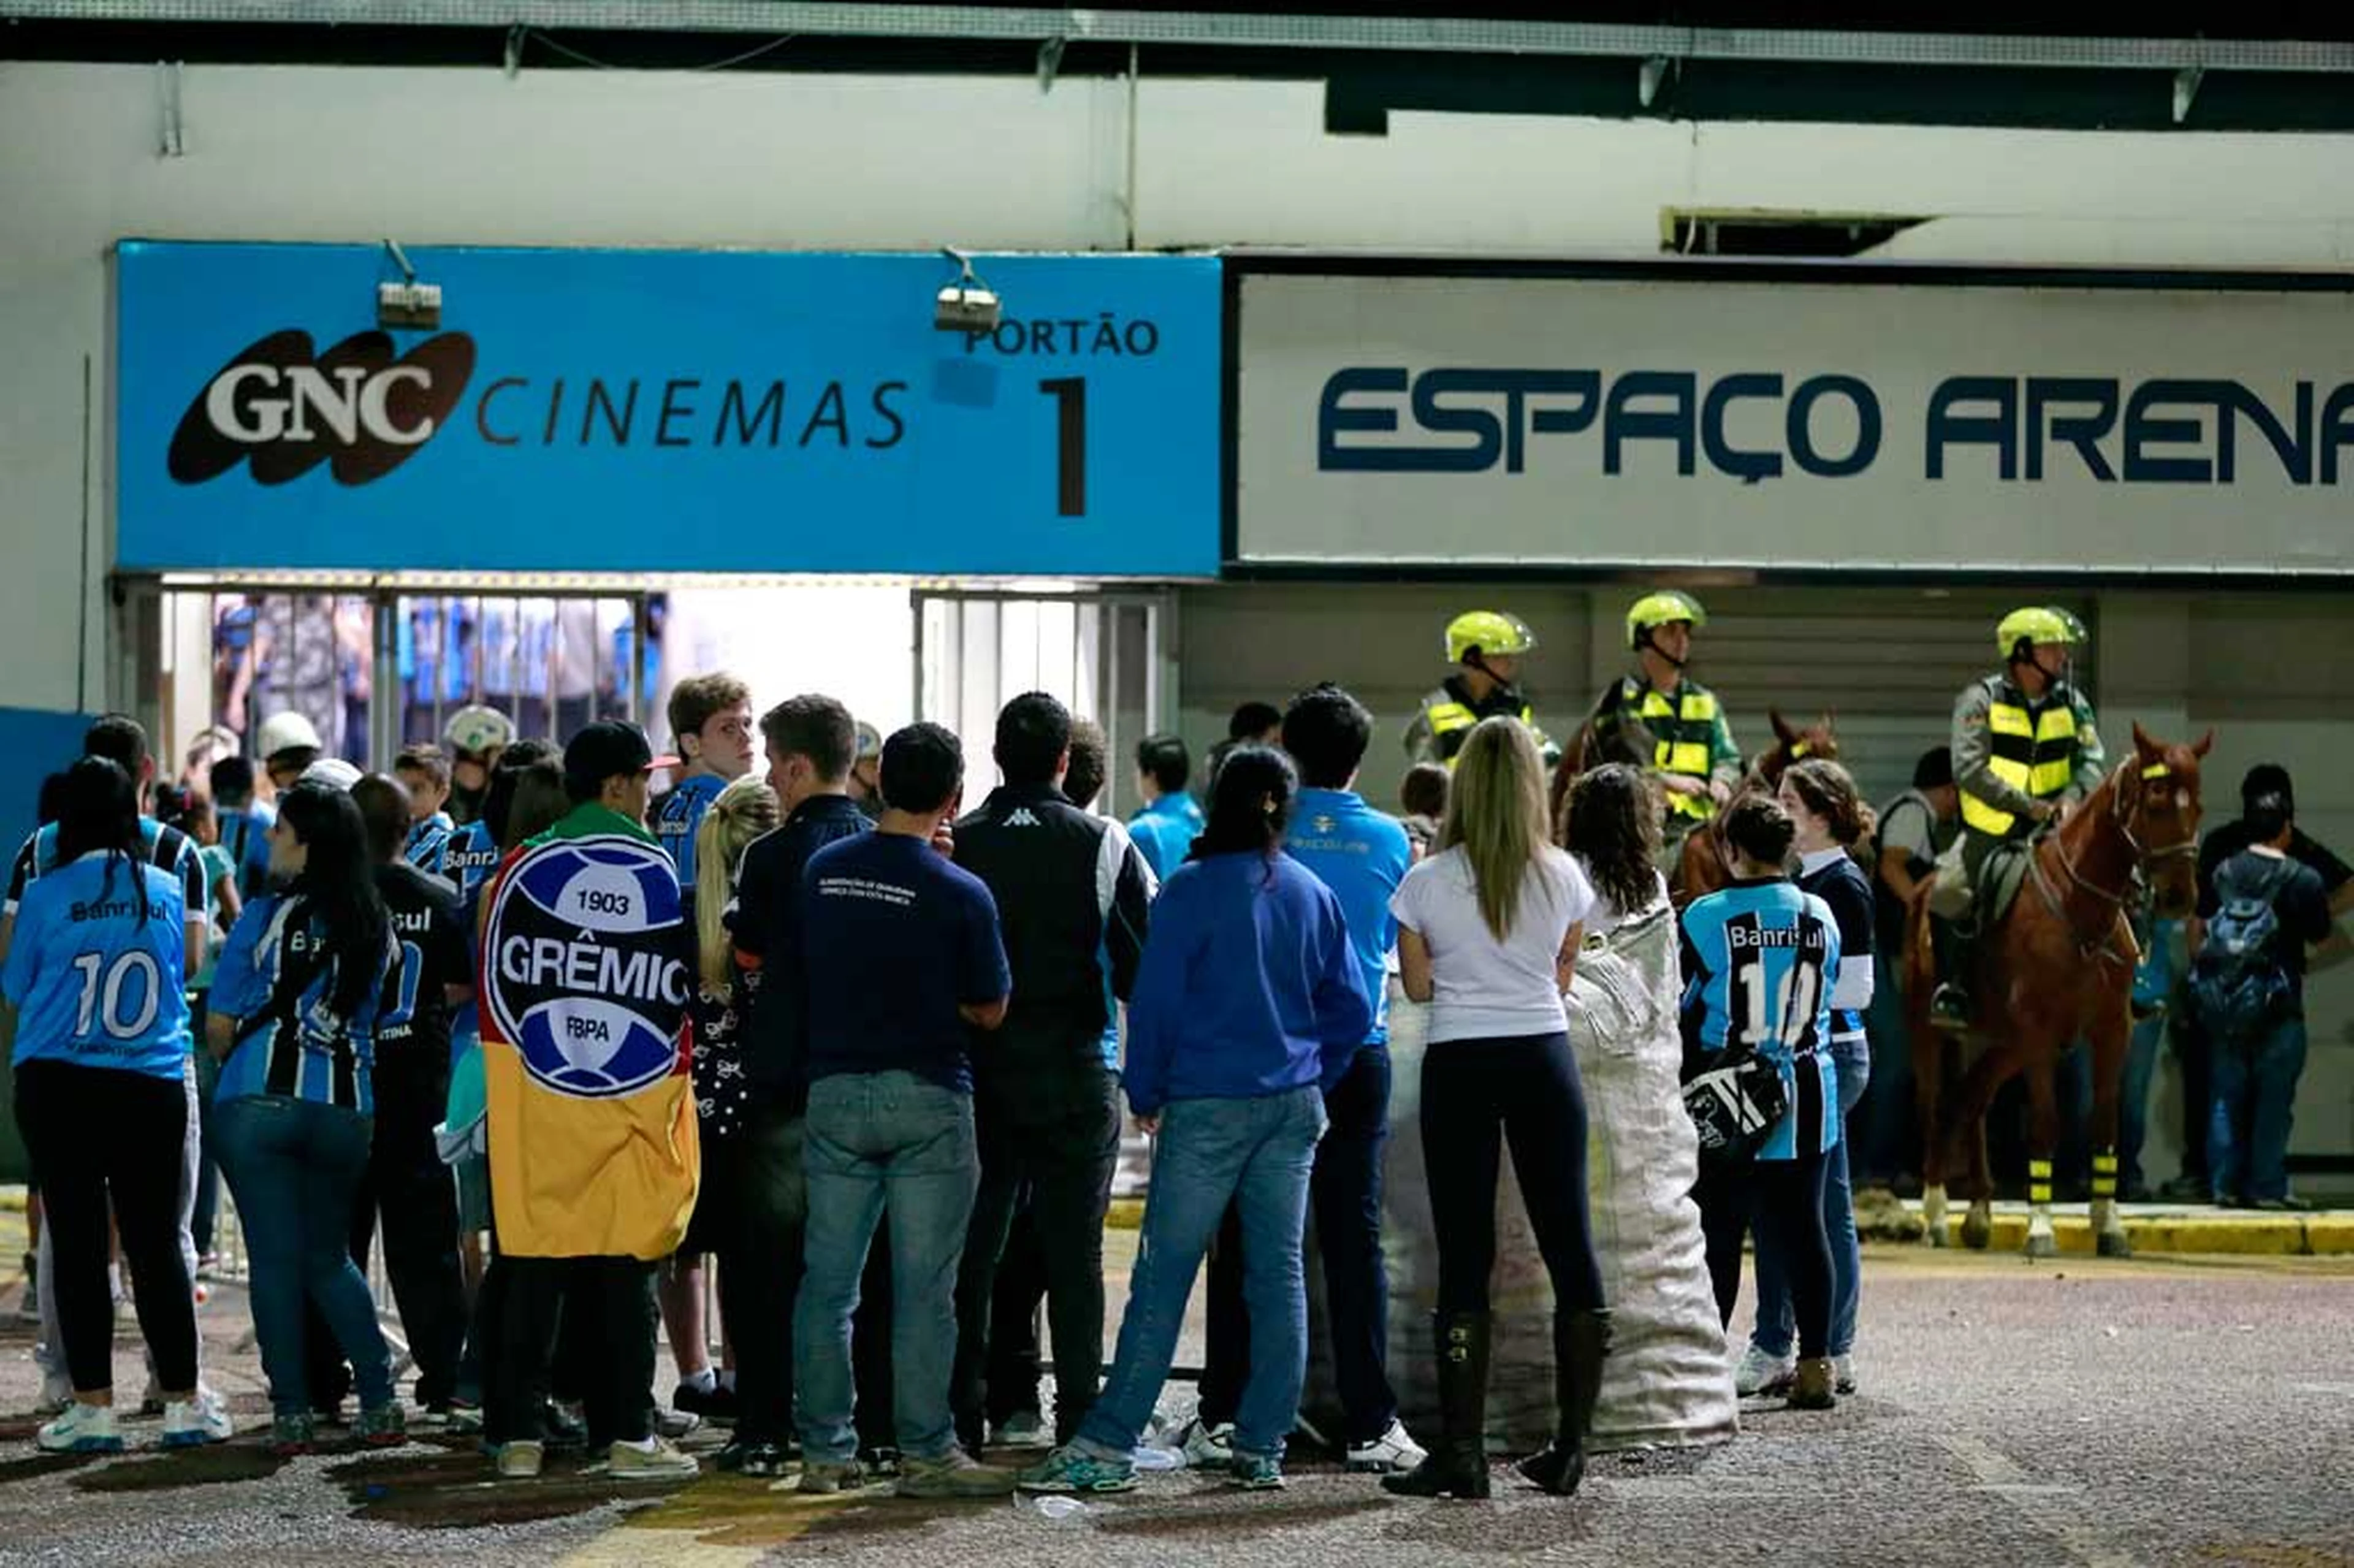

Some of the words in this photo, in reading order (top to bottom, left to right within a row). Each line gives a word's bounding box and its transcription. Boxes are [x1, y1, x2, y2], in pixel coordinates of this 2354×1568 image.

[965, 311, 1159, 356] PORTÃO
[206, 364, 433, 445] GNC
[476, 376, 910, 449] CINEMAS
[1317, 367, 1882, 485] ESPAÇO
[1039, 376, 1085, 516] 1
[443, 845, 498, 870] Banri
[71, 899, 167, 922] Banriul
[576, 890, 629, 916] 1903
[72, 949, 162, 1041] 10
[501, 929, 690, 1007] GRÊMIO
[1739, 960, 1816, 1048] 10
[566, 1016, 610, 1042] FBPA
